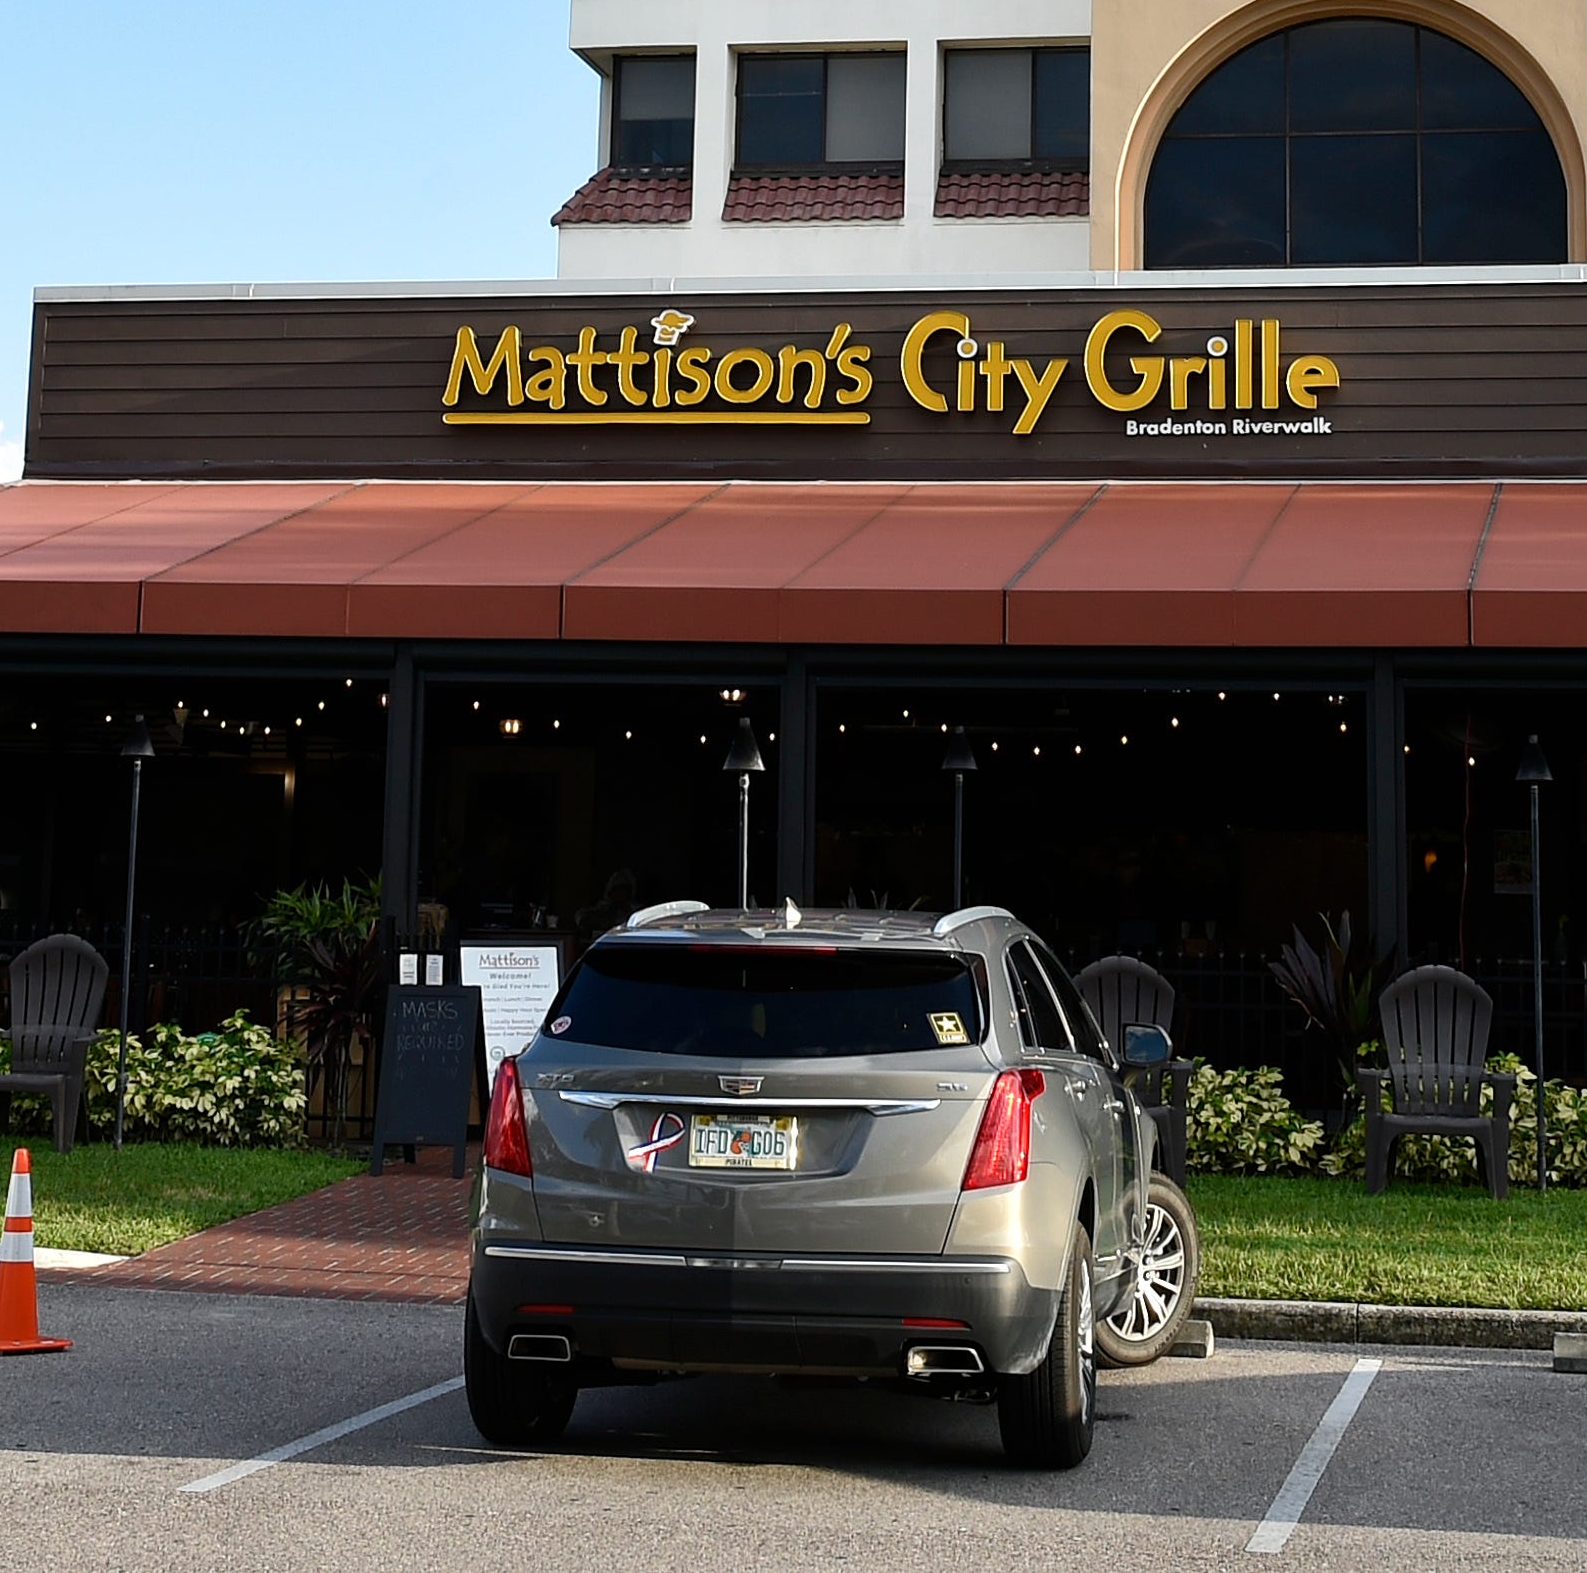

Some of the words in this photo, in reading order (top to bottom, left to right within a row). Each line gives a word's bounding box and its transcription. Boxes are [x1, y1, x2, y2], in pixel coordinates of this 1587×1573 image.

[442, 314, 874, 410] Mattison's
[901, 310, 1069, 435] City
[1084, 309, 1340, 413] Grille
[1126, 418, 1227, 436] Bradenton
[1232, 416, 1332, 435] Riverwalk
[479, 952, 540, 968] Mattison's
[490, 972, 532, 980] Welcome!
[403, 1000, 459, 1020] MASKS
[397, 1033, 465, 1051] REQUIRED
